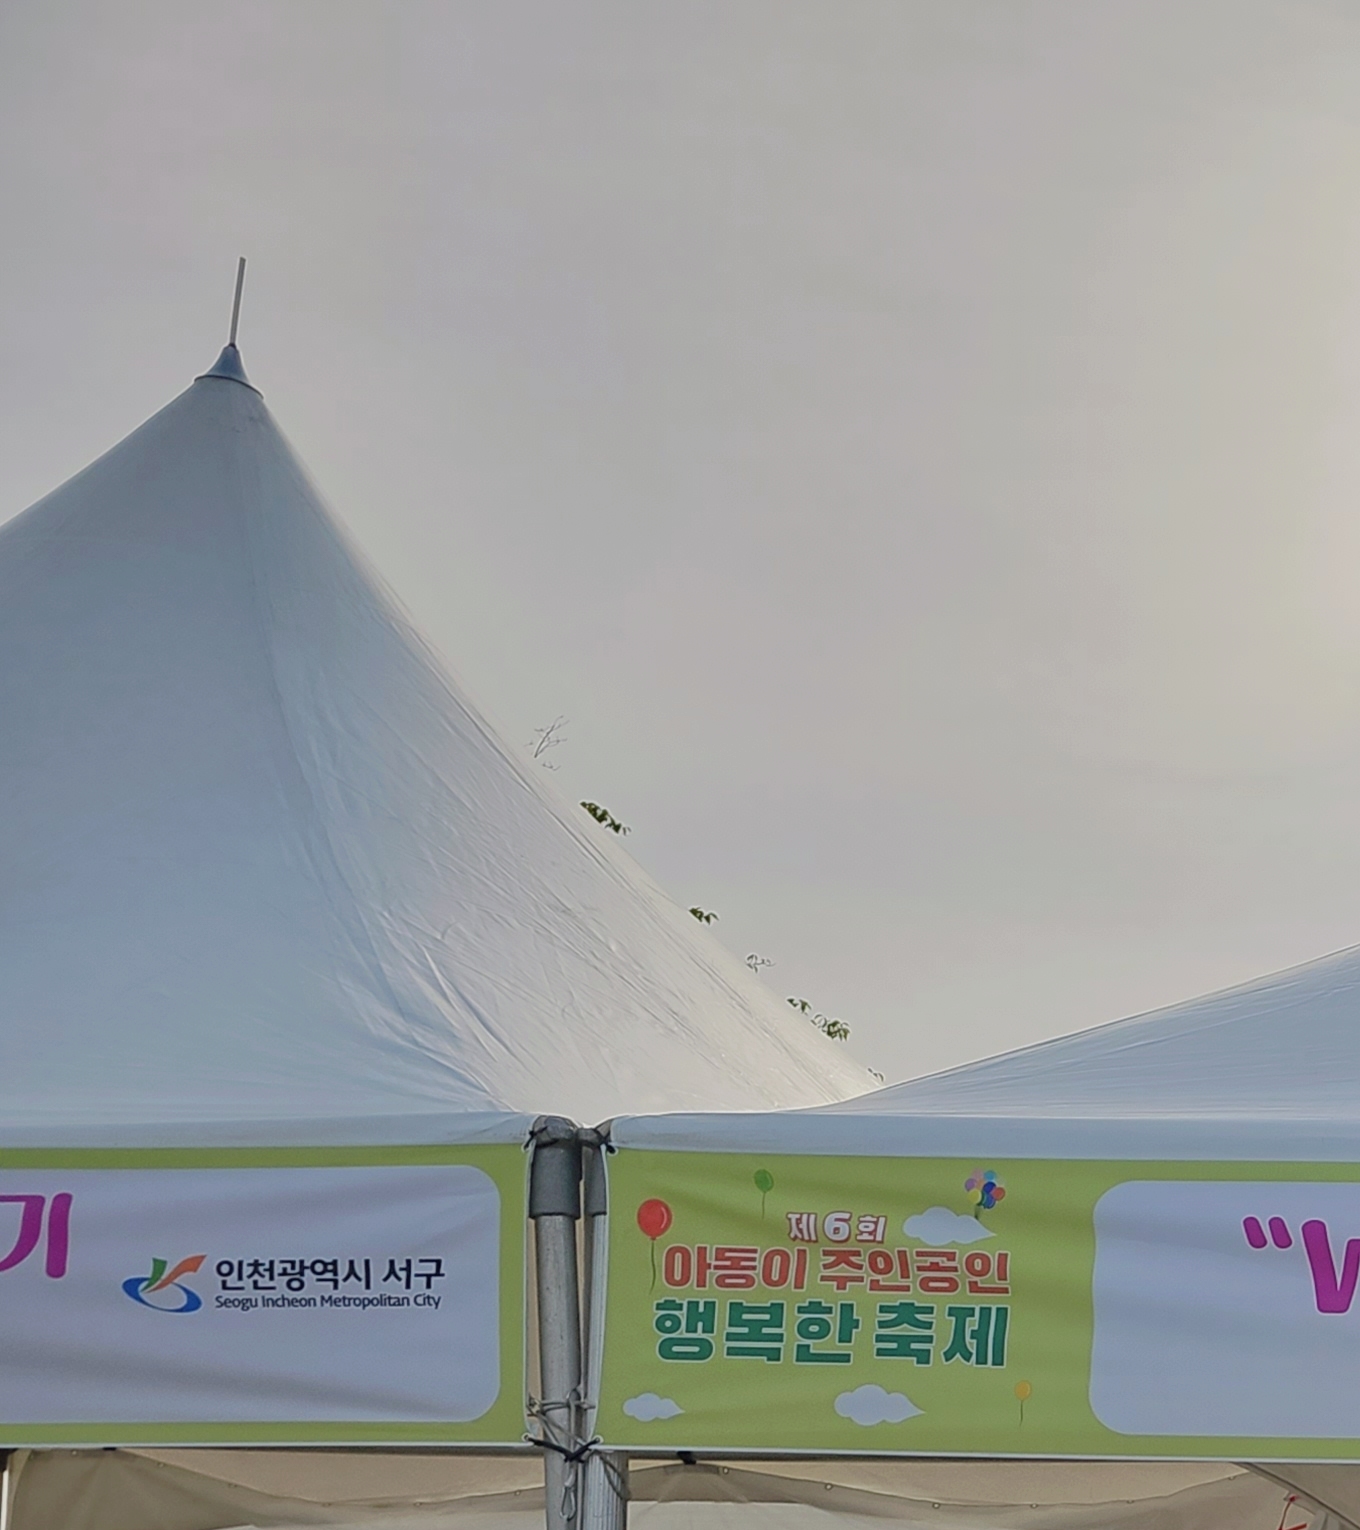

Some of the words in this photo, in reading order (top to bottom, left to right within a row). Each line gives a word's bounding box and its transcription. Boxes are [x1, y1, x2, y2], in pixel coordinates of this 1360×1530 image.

[215, 1258, 372, 1292] 인천광역시
[382, 1258, 446, 1291] 서구
[662, 1244, 808, 1292] 아동이
[818, 1247, 1012, 1296] 주인공인
[215, 1294, 259, 1312] Seogu
[261, 1293, 318, 1308] Incheon
[320, 1293, 411, 1311] Metropolitan
[413, 1293, 442, 1310] City
[654, 1297, 862, 1366] 행복한
[873, 1300, 1011, 1368] 축제
